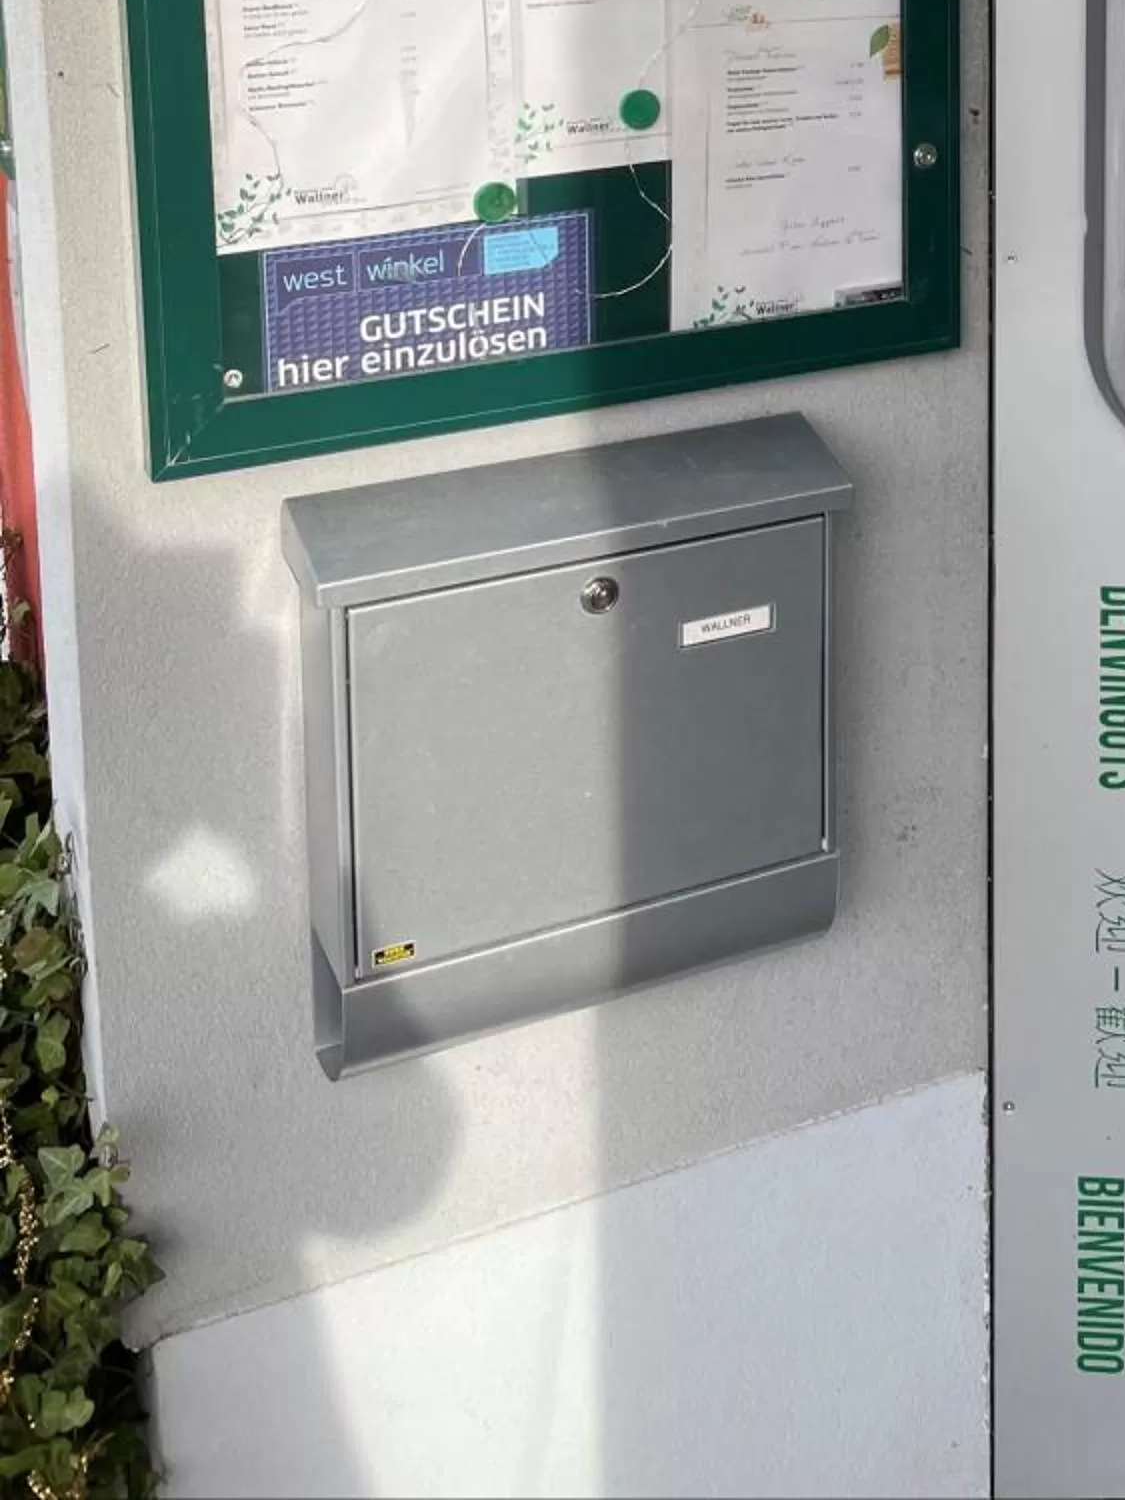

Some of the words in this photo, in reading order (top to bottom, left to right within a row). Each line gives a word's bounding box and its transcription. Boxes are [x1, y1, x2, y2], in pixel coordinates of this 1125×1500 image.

[283, 263, 348, 292] west
[366, 249, 445, 283] winkel
[360, 291, 546, 343] GUTSCHEIN
[278, 352, 351, 388] hier
[361, 324, 548, 375] einzulösen
[700, 613, 751, 634] WALLNER
[1076, 1176, 1125, 1374] BIENVENIDO
